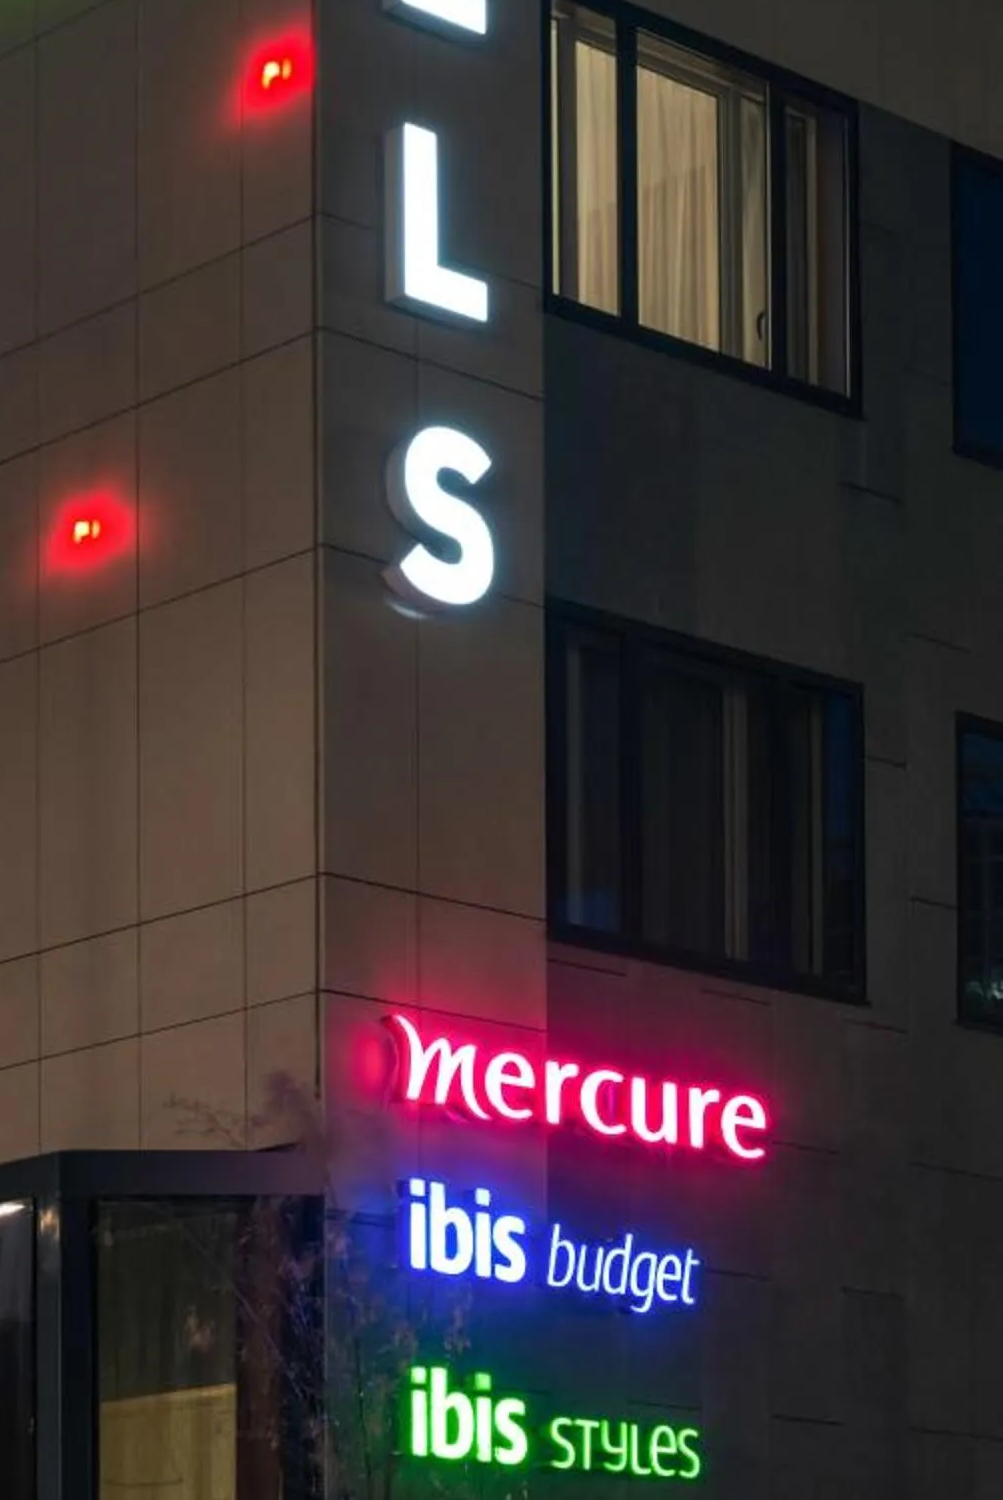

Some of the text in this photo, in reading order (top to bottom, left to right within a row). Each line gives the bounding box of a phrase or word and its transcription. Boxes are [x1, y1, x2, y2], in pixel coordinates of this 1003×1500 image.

[408, 1178, 701, 1314] ibis budget
[410, 1366, 528, 1466] ibis
